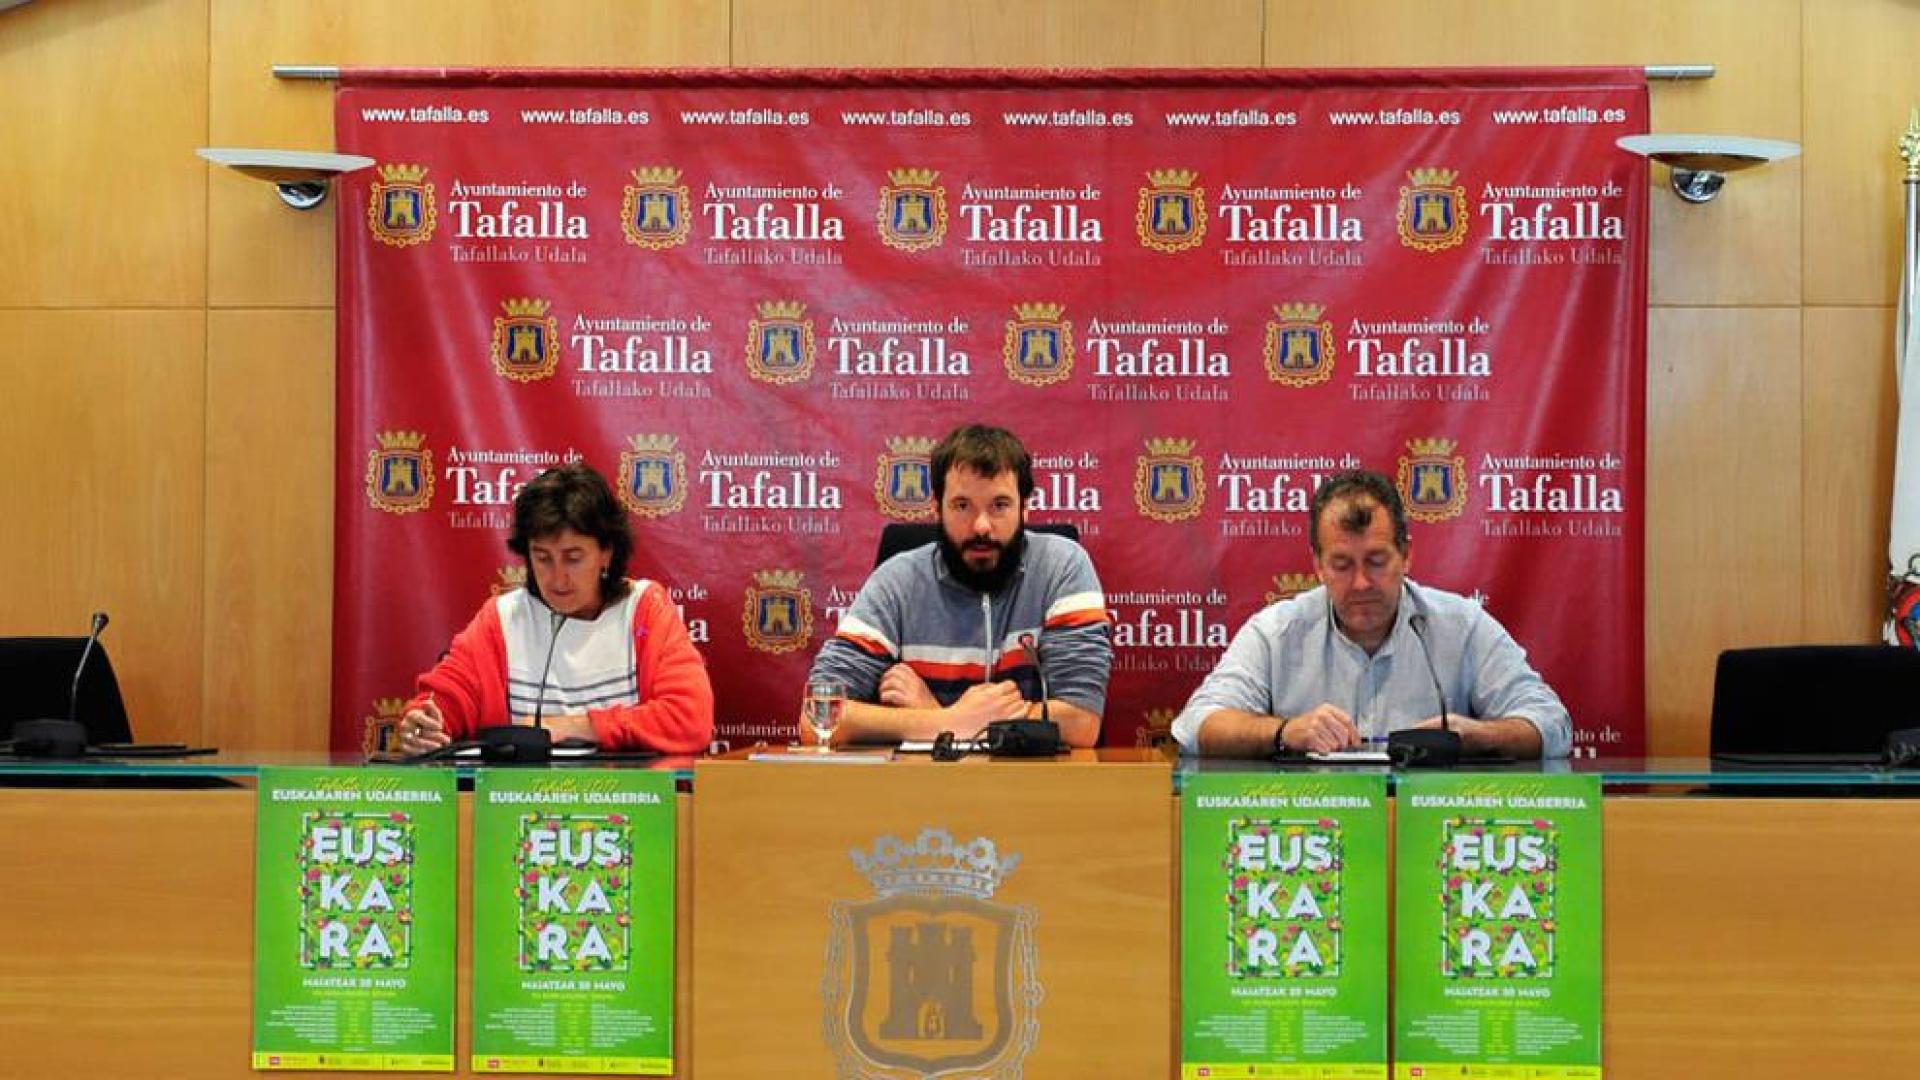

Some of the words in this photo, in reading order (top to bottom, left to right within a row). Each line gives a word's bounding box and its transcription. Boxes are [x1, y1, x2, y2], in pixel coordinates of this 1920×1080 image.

[362, 106, 489, 122] www.tafalla.es
[521, 108, 648, 124] www.tafalla.es
[681, 108, 809, 124] www.tafalla.es
[842, 109, 970, 126] www.tafalla.es
[1003, 109, 1133, 126] www.tafalla.es
[1166, 109, 1296, 126] www.tafalla.es
[1330, 108, 1461, 125] www.tafalla.es
[1493, 106, 1625, 124] www.tafalla.es
[451, 181, 561, 203] Ayuntamiento
[565, 181, 587, 200] de
[706, 182, 816, 204] Ayuntamiento
[821, 182, 843, 201] de
[962, 183, 1075, 205] Ayuntamiento
[1079, 183, 1101, 202] de
[1222, 183, 1335, 205] Ayuntamiento
[1339, 183, 1362, 202] de
[1482, 181, 1597, 204] Ayuntamiento
[1601, 181, 1622, 201] de
[449, 201, 588, 239] Tafalla
[703, 203, 844, 241] Tafalla
[959, 205, 1102, 242] Tafalla
[1219, 205, 1363, 242] Tafalla
[1480, 202, 1624, 240] Tafalla
[450, 245, 527, 263] Tafallako
[535, 245, 586, 263] Udala
[703, 247, 782, 265] Tafallako
[790, 247, 843, 265] Udala
[961, 248, 1041, 266] Tafallako
[1049, 248, 1101, 266] Udala
[1221, 249, 1301, 266] Tafallako
[1310, 249, 1362, 266] Udala
[1482, 247, 1562, 265] Tafallako
[1571, 247, 1622, 265] Udala
[574, 314, 685, 336] Ayuntamiento
[689, 314, 711, 333] de
[831, 316, 942, 337] Ayuntamiento
[947, 316, 969, 334] de
[1088, 317, 1202, 339] Ayuntamiento
[1207, 317, 1229, 336] de
[1350, 317, 1463, 339] Ayuntamiento
[1467, 317, 1490, 336] de
[571, 335, 712, 373] Tafalla
[828, 337, 970, 375] Tafalla
[1086, 339, 1230, 377] Tafalla
[1347, 338, 1491, 377] Tafalla
[572, 379, 651, 398] Tafallako
[659, 379, 711, 398] Udala
[830, 381, 909, 400] Tafallako
[917, 381, 969, 400] Udala
[1088, 383, 1168, 401] Tafallako
[1176, 383, 1229, 401] Udala
[1349, 383, 1429, 401] Tafallako
[1438, 383, 1490, 401] Udala
[448, 446, 559, 467] Ayuntamiento
[563, 447, 583, 465] de
[702, 449, 814, 471] Ayuntamiento
[818, 450, 841, 468] de
[1220, 452, 1335, 473] Ayuntamiento
[1339, 453, 1361, 470] de
[1482, 452, 1596, 474] Ayuntamiento
[1599, 453, 1621, 471] de
[700, 469, 842, 509] Tafalla
[1027, 472, 1102, 511] alla
[1480, 473, 1624, 512] Tafalla
[701, 515, 780, 534] Tafallako
[788, 516, 841, 534] Udala
[1220, 519, 1301, 537] Tafallako
[1482, 519, 1560, 537] Tafallako
[1569, 519, 1622, 537] Udala
[1105, 588, 1202, 605] untamiento
[1206, 588, 1227, 605] de
[1110, 608, 1231, 648] afalla
[312, 827, 406, 864] EUS
[528, 829, 624, 866] EUS
[1239, 834, 1333, 871] EUS
[1453, 834, 1549, 871] EUS
[320, 873, 394, 912] KA
[538, 876, 613, 914] KA
[1247, 881, 1324, 919] KA
[1461, 881, 1538, 920] KA
[319, 921, 394, 958] RA
[538, 923, 613, 961] RA
[1247, 929, 1324, 967] RA
[1461, 929, 1538, 968] RA
